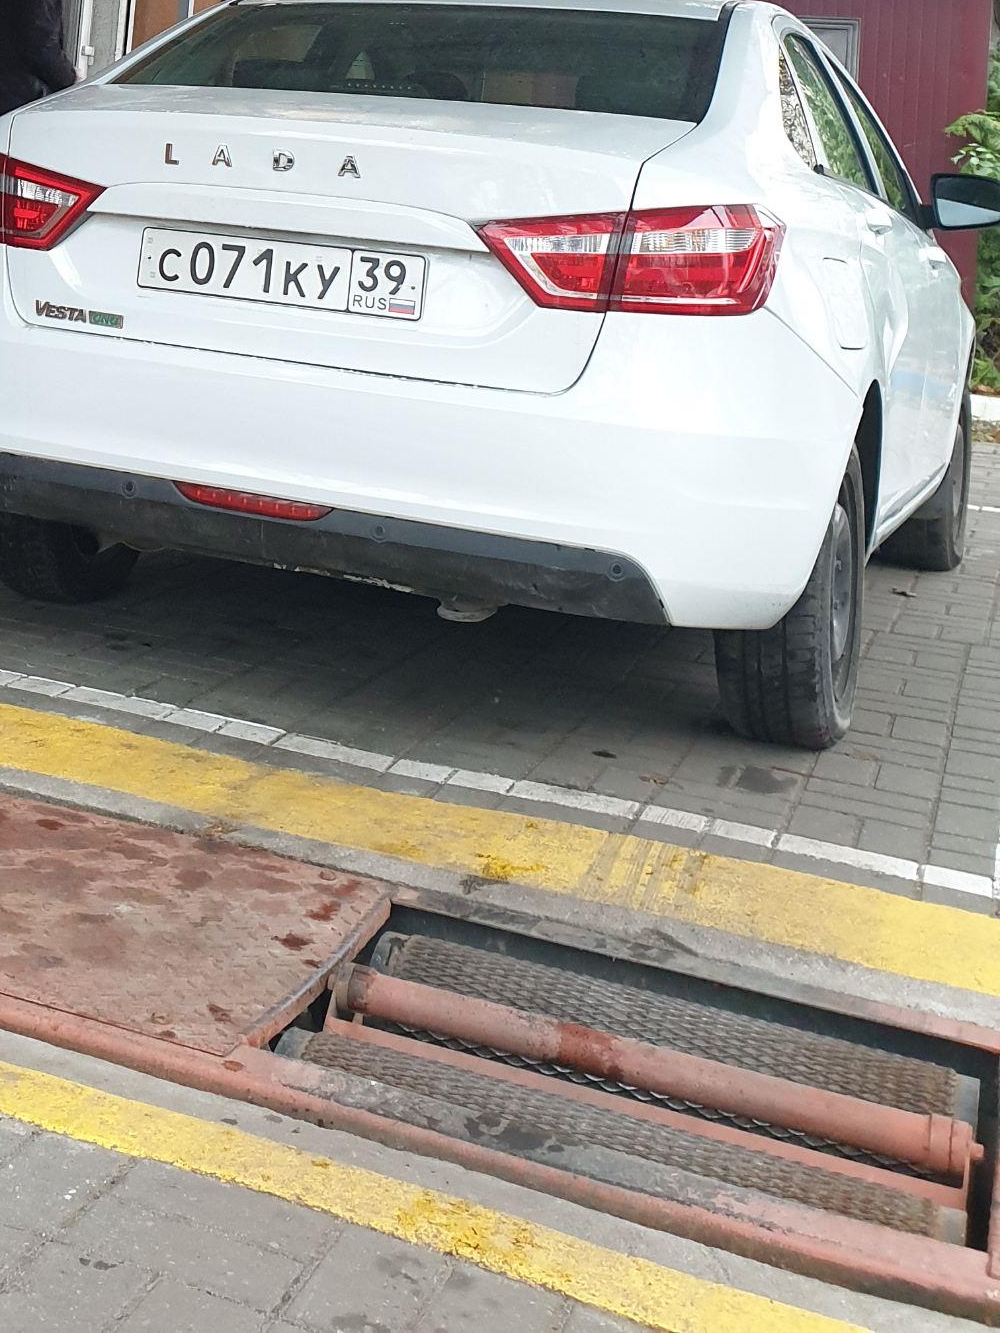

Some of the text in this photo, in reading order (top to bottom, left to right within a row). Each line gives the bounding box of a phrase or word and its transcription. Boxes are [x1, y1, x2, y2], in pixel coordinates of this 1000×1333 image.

[163, 143, 361, 179] LADA
[357, 256, 407, 295] 39
[35, 299, 87, 323] VESTA
[352, 294, 387, 310] RUS
